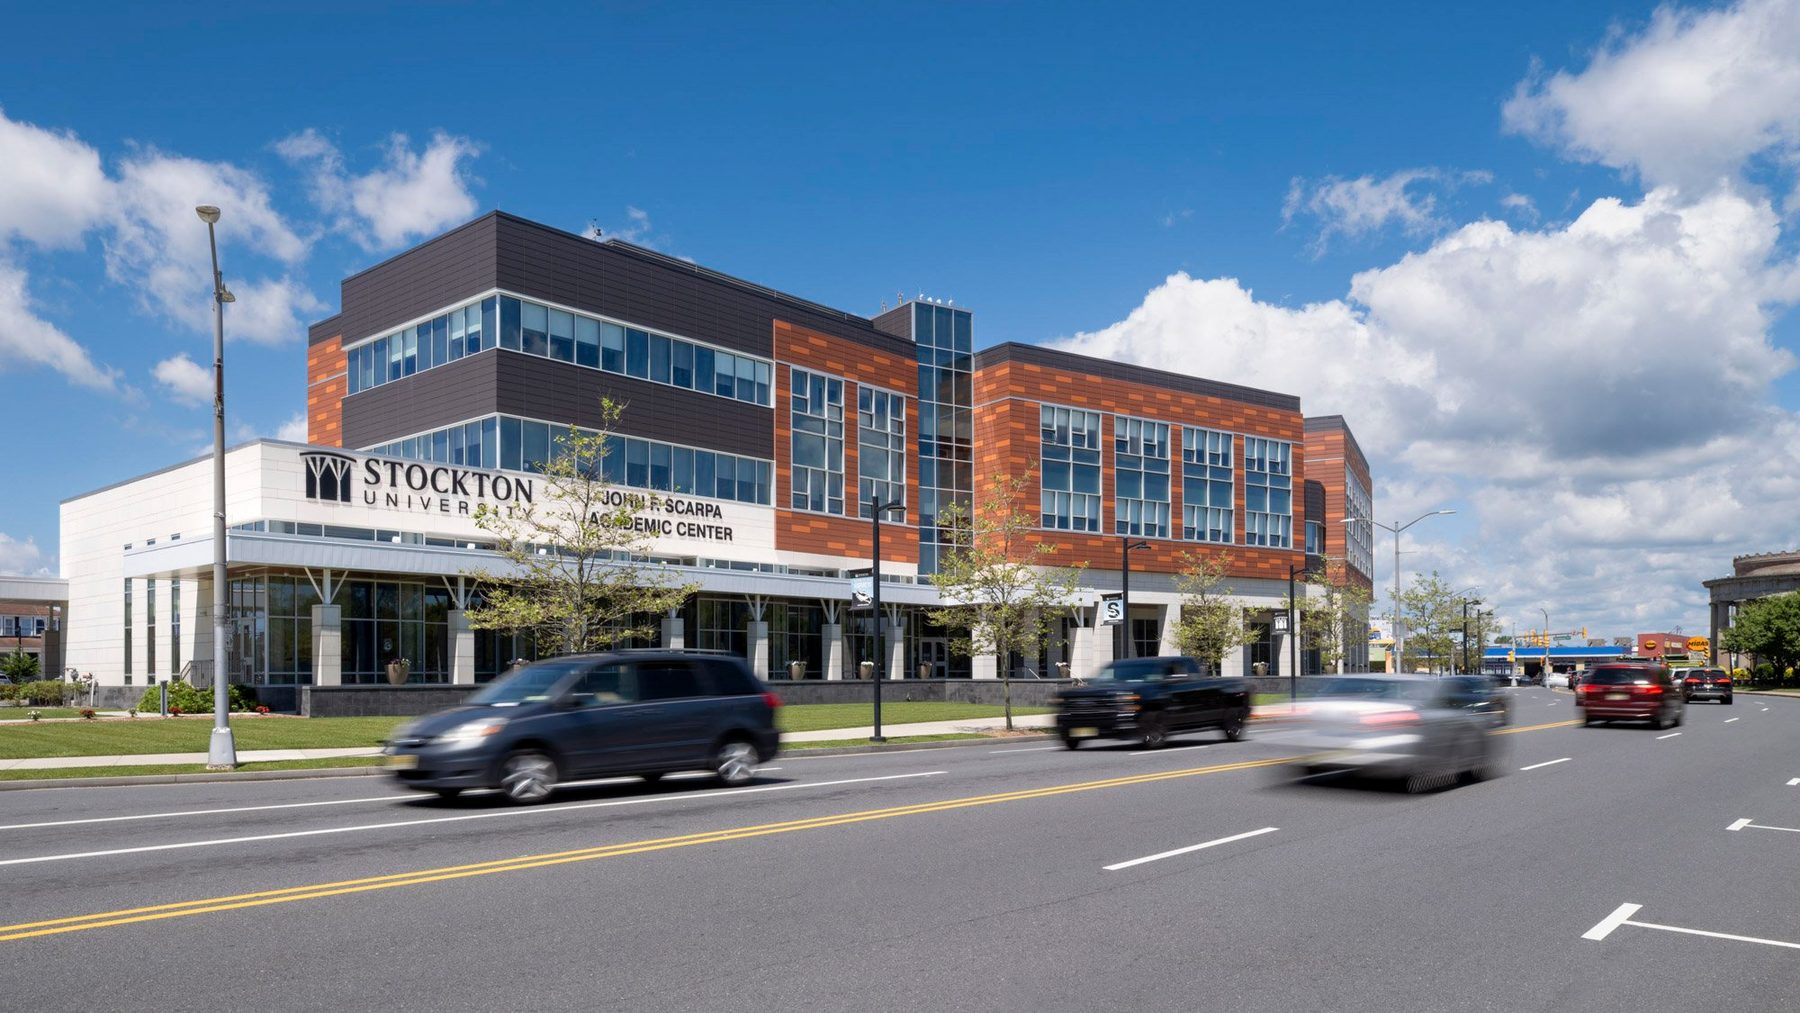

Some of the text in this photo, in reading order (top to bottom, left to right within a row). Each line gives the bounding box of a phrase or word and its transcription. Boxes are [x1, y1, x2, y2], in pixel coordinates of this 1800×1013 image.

[364, 458, 532, 503] STOCKTON
[602, 490, 645, 510] JOHN
[665, 498, 722, 519] SCARPA
[589, 511, 733, 541] ACDEMIC CENTER
